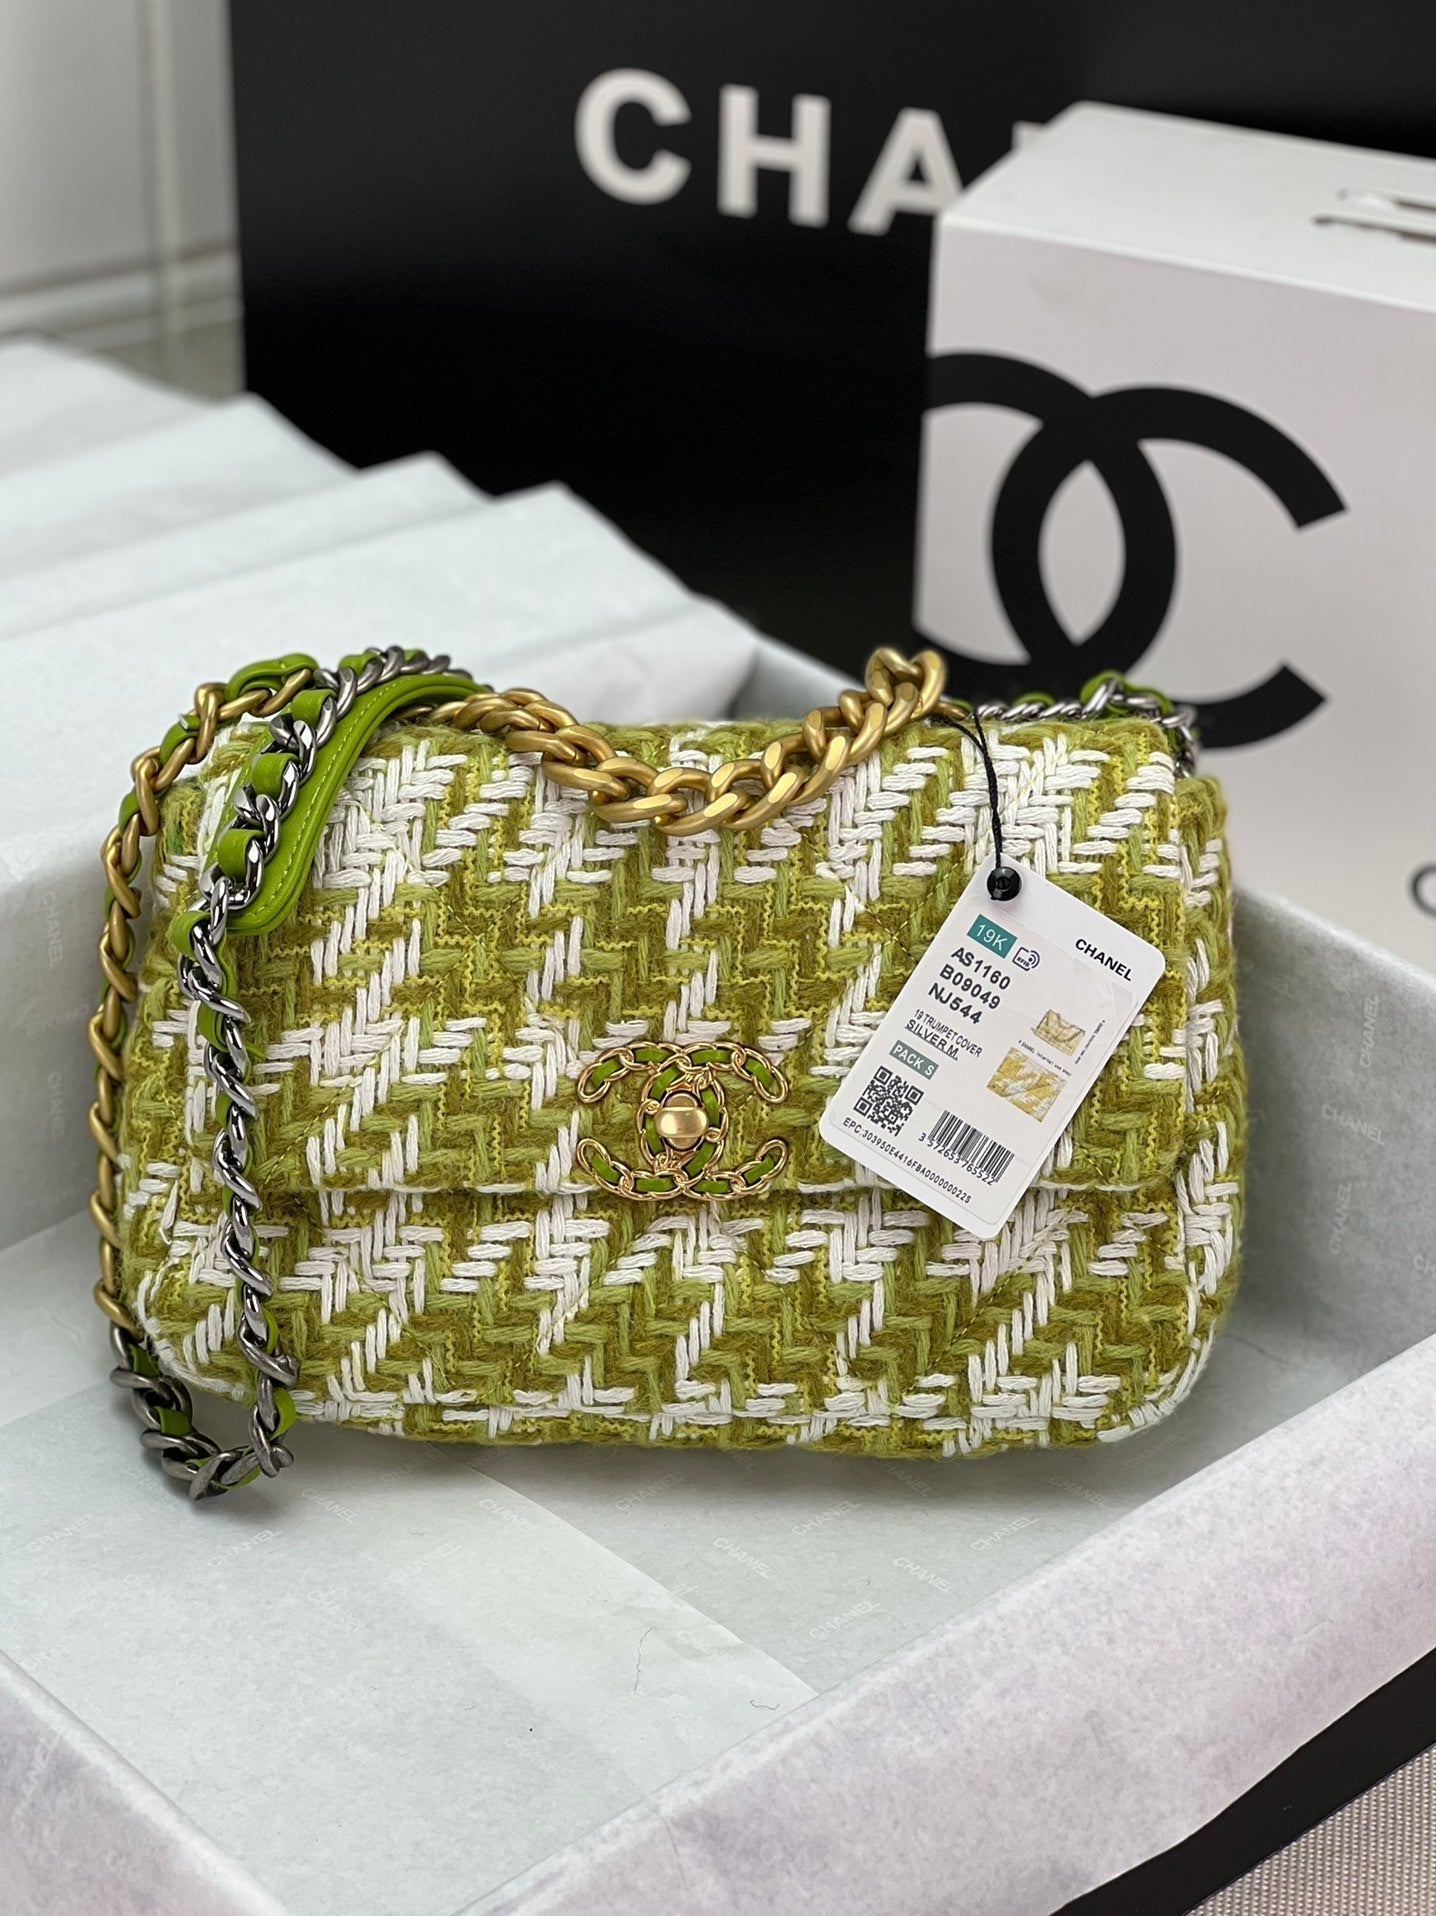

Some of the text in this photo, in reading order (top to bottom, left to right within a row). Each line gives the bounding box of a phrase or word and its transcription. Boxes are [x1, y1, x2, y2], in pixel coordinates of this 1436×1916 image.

[574, 67, 1056, 236] CHA
[973, 921, 1008, 951] 19K
[949, 944, 1013, 991] AS1160
[1073, 936, 1136, 982] CHANEL
[926, 981, 984, 1025] NJ544
[938, 962, 1003, 1011] B09049
[905, 1018, 948, 1050] SILVER
[912, 1008, 983, 1058] 19 TRUMPET COVER
[1359, 995, 1380, 1068] CHANEL
[892, 1043, 935, 1077] PACK S
[1321, 1103, 1386, 1146] CHANEL
[917, 1131, 996, 1186] 3 572653 765522
[791, 1499, 863, 1536] CHANEL
[971, 1513, 1041, 1552] CHANEL
[713, 1537, 775, 1580] CHANEL
[892, 1556, 954, 1594] CHANEL
